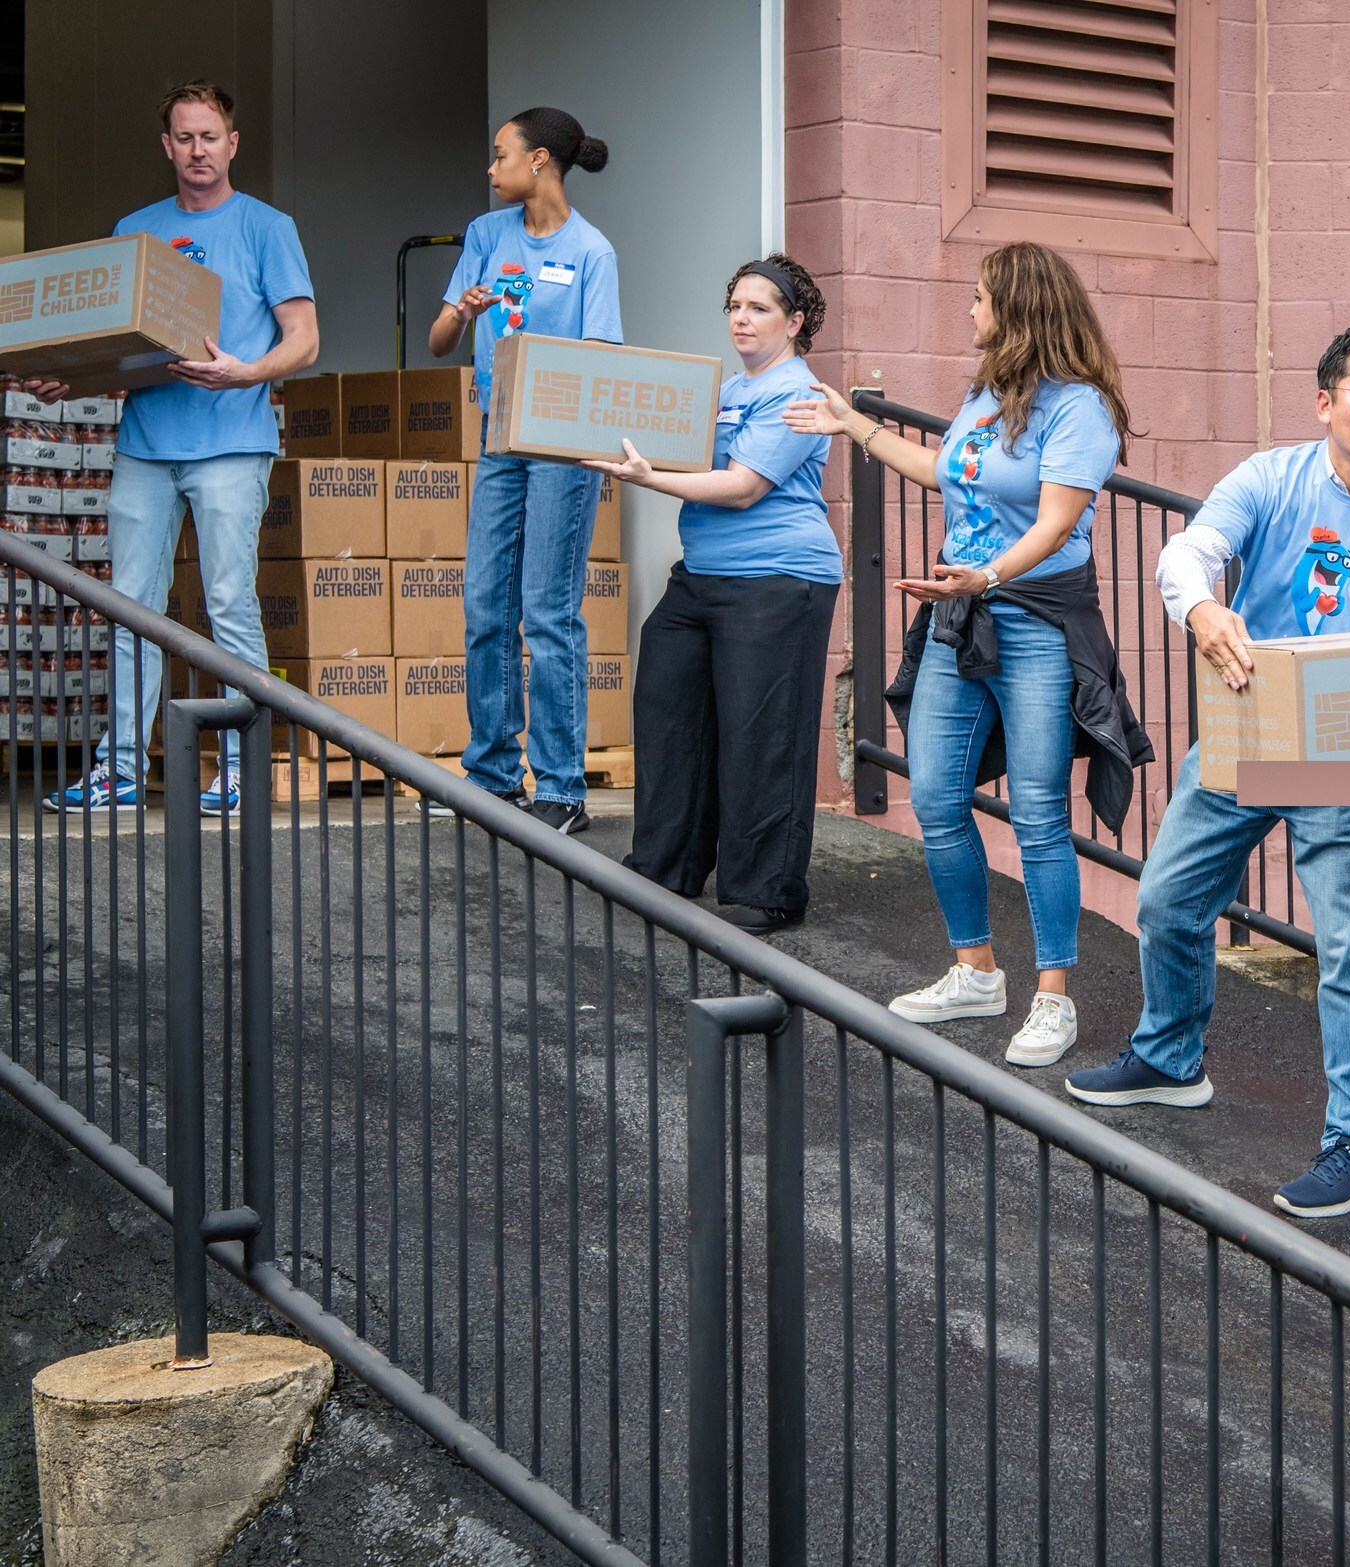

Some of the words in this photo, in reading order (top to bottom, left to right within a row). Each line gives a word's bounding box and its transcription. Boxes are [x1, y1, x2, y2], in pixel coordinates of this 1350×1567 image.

[42, 266, 109, 301] FEED
[110, 264, 122, 288] THE
[591, 376, 677, 414] FEED
[681, 388, 694, 415] THE
[291, 410, 311, 422] AUTO
[312, 408, 330, 421] DISH
[350, 405, 370, 419] AUTO
[371, 404, 389, 418] DISH
[410, 403, 430, 417] AUTO
[432, 402, 451, 416] DISH
[290, 422, 332, 438] DETERGENT
[348, 419, 391, 434] DETERGENT
[407, 416, 452, 432] DETERGENT
[311, 467, 343, 482] AUTO
[347, 467, 375, 481] DISH
[397, 470, 428, 484] AUTO
[432, 470, 458, 484] DISH
[309, 482, 378, 497] DETERGENT
[395, 485, 461, 500] DETERGENT
[316, 567, 349, 581] AUTO
[353, 567, 380, 581] DISH
[403, 568, 434, 582] AUTO
[438, 568, 463, 582] DISH
[594, 569, 619, 583] DISH
[314, 582, 384, 597] DETERGENT
[583, 584, 621, 598] ERGENT
[278, 596, 297, 609] DISH
[321, 666, 353, 681] AUTO
[356, 665, 385, 679] DISH
[408, 666, 438, 680] AUTO
[596, 662, 621, 676] DISH
[318, 680, 389, 697] DETERGENT
[405, 680, 466, 696] DETERGEN
